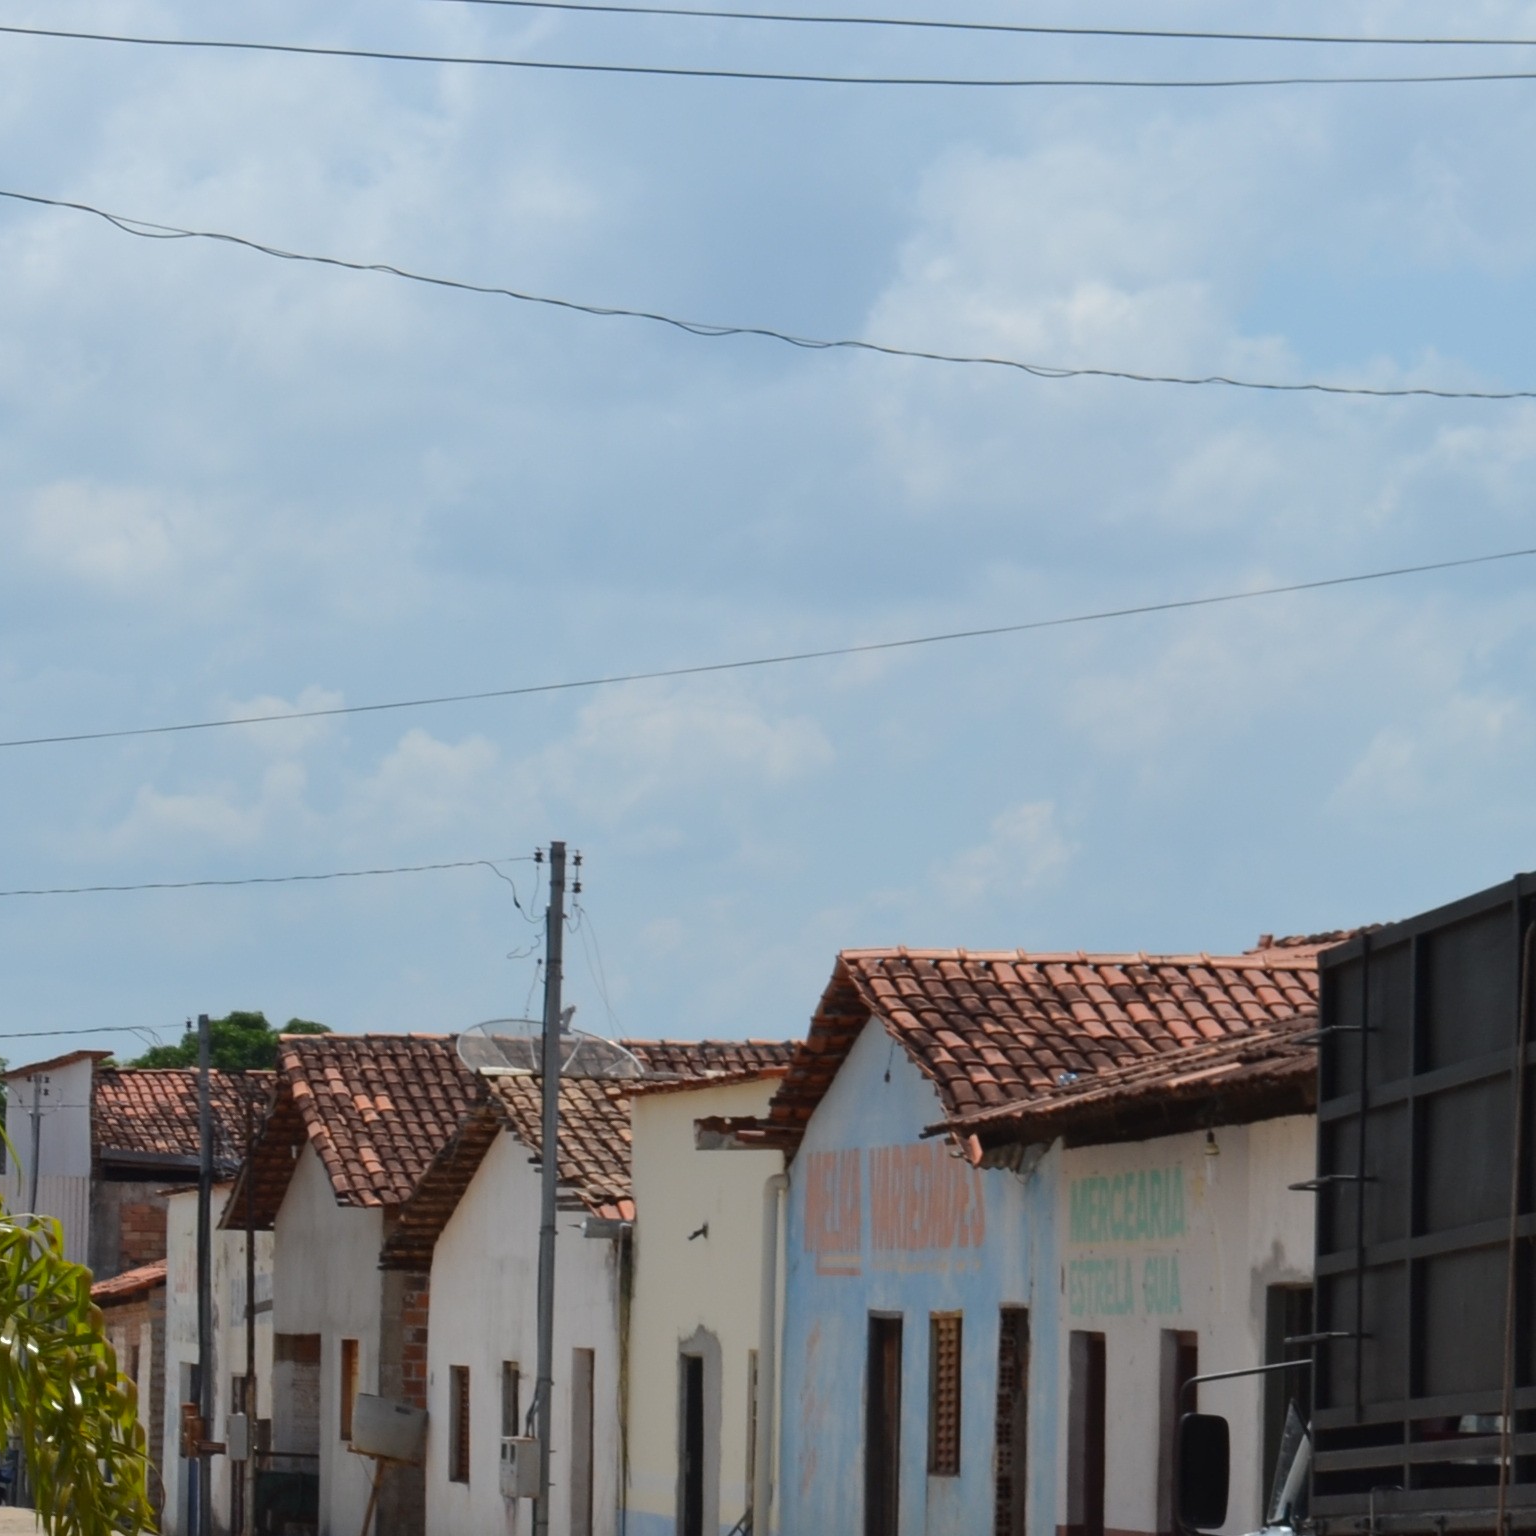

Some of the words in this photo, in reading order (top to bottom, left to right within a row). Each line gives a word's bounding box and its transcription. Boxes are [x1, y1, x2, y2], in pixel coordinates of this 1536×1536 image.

[1070, 1166, 1185, 1243] MERCEARIA
[1070, 1256, 1134, 1316] ESTRELA
[1144, 1256, 1182, 1315] GUIA
